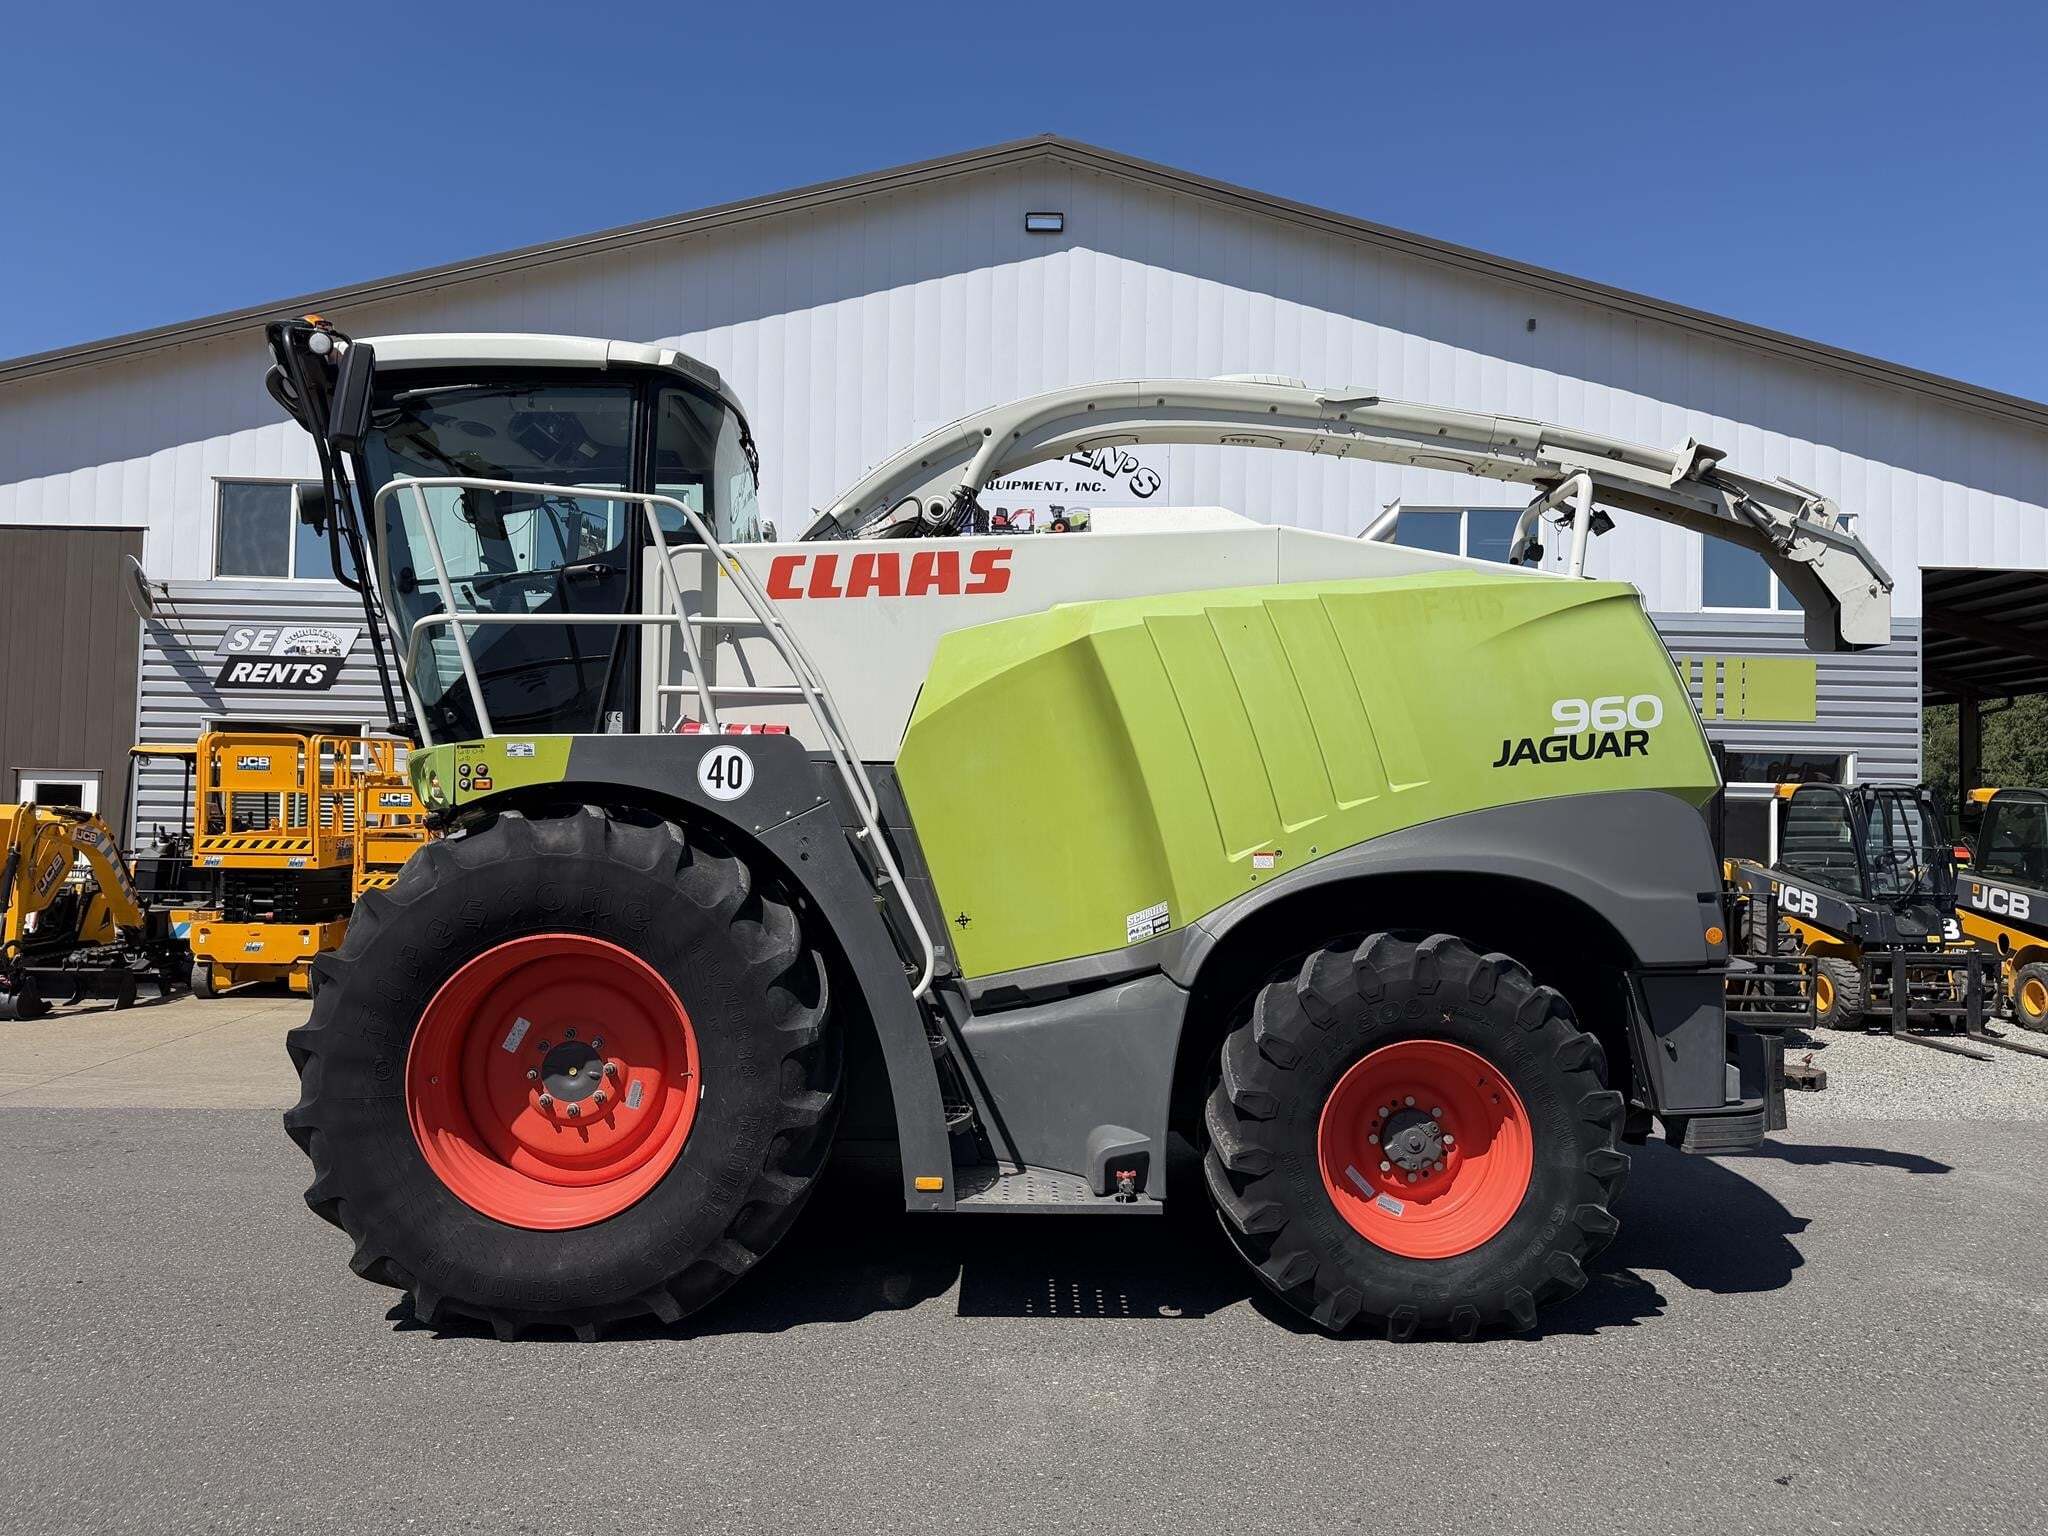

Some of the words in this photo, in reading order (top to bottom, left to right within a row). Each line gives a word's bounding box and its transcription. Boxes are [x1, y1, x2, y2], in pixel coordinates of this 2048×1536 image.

[984, 480, 1068, 493] QUIPMENT,
[1075, 481, 1107, 492] INC.
[766, 549, 1013, 600] CLAAS
[226, 628, 278, 651] SE
[227, 662, 327, 684] RENTS
[1551, 694, 1663, 735] 960
[237, 756, 269, 766] JCB
[1492, 729, 1649, 768] JAGUAR
[707, 755, 743, 789] 40
[379, 793, 412, 803] JCB
[76, 830, 97, 842] JCB
[39, 854, 63, 892] JCB
[1775, 883, 1818, 919] JCB
[1972, 885, 2030, 919] JCB
